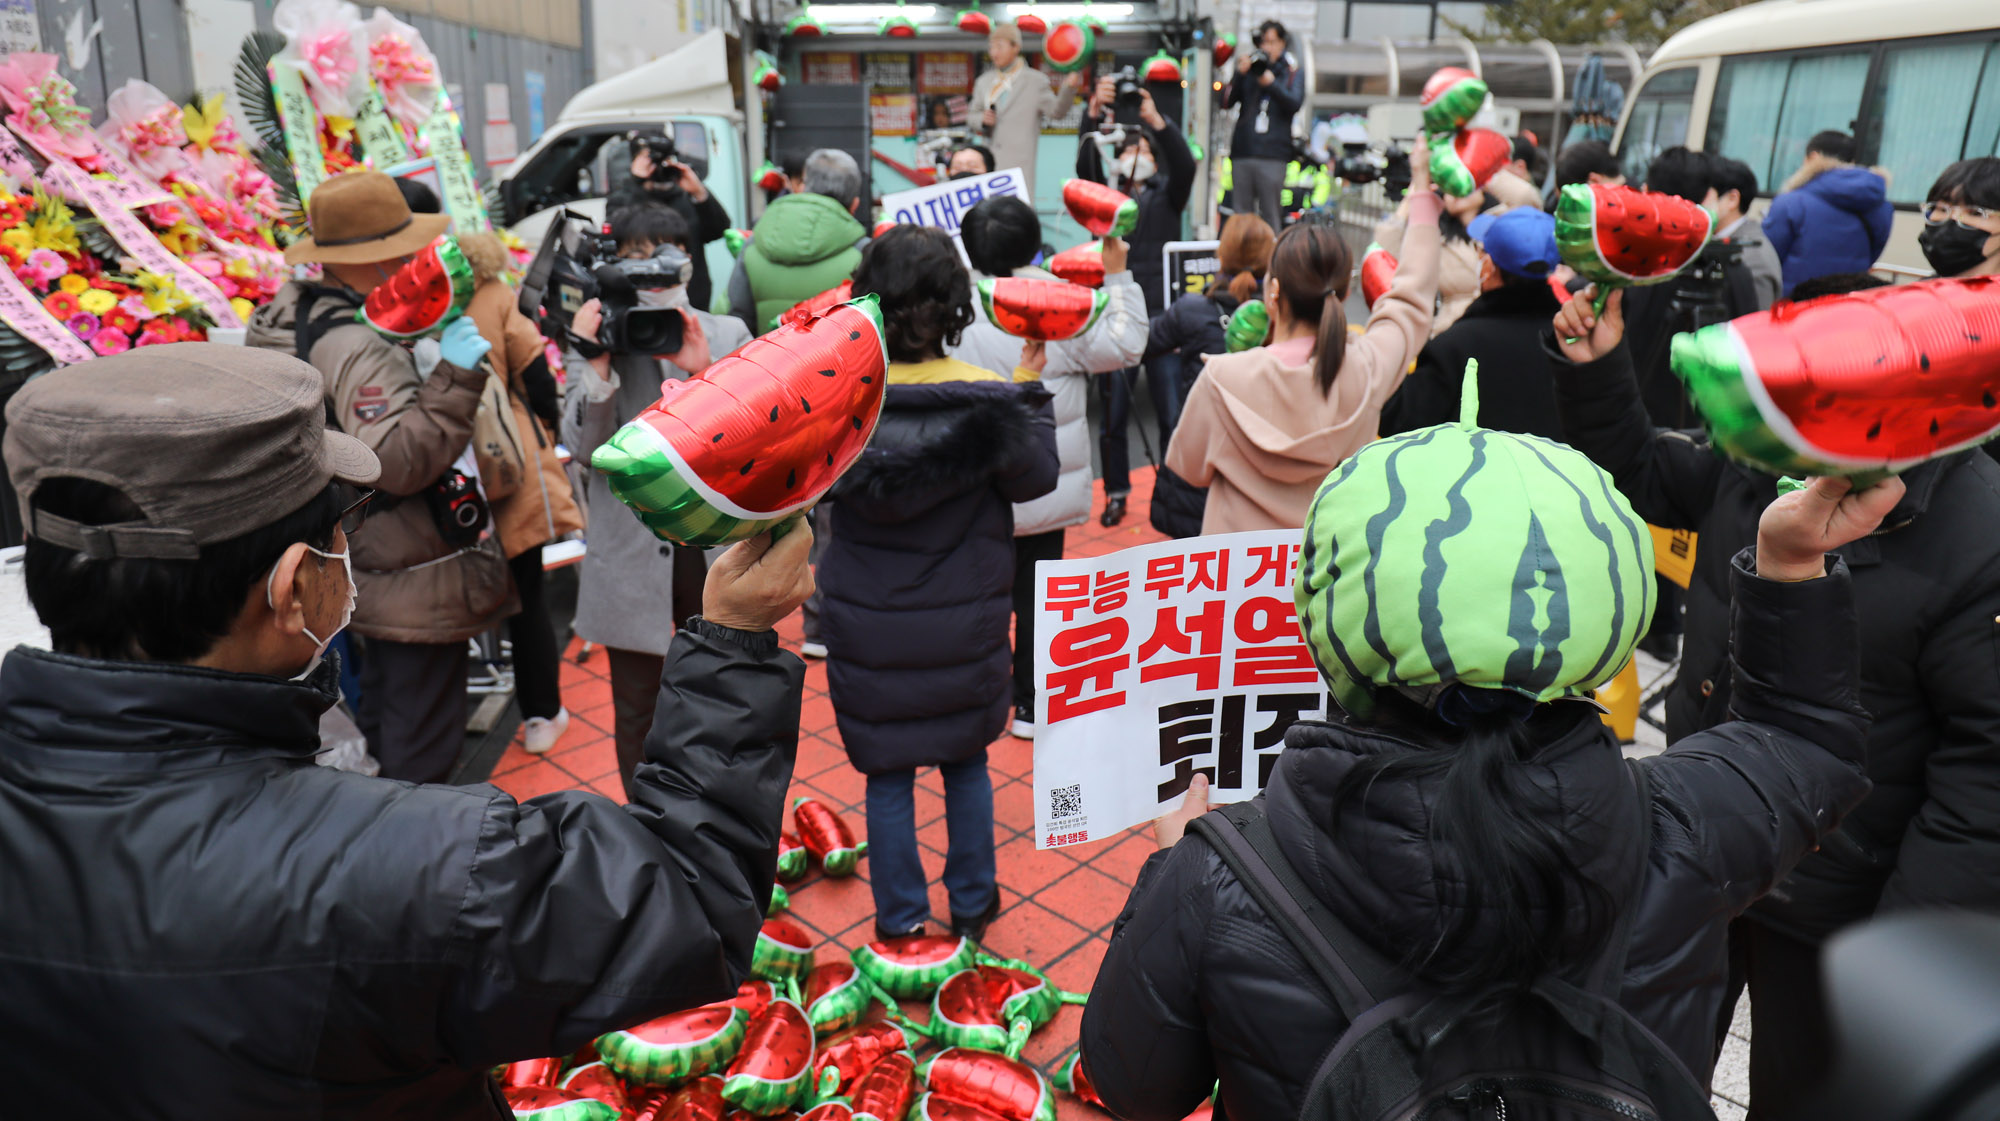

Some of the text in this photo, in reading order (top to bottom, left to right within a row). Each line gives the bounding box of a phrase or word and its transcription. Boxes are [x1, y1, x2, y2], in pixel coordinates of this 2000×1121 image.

[1045, 544, 1302, 622] 무능 무지 거
[1046, 596, 1319, 725] 윤석열
[1046, 830, 1088, 847] 촛불행동
